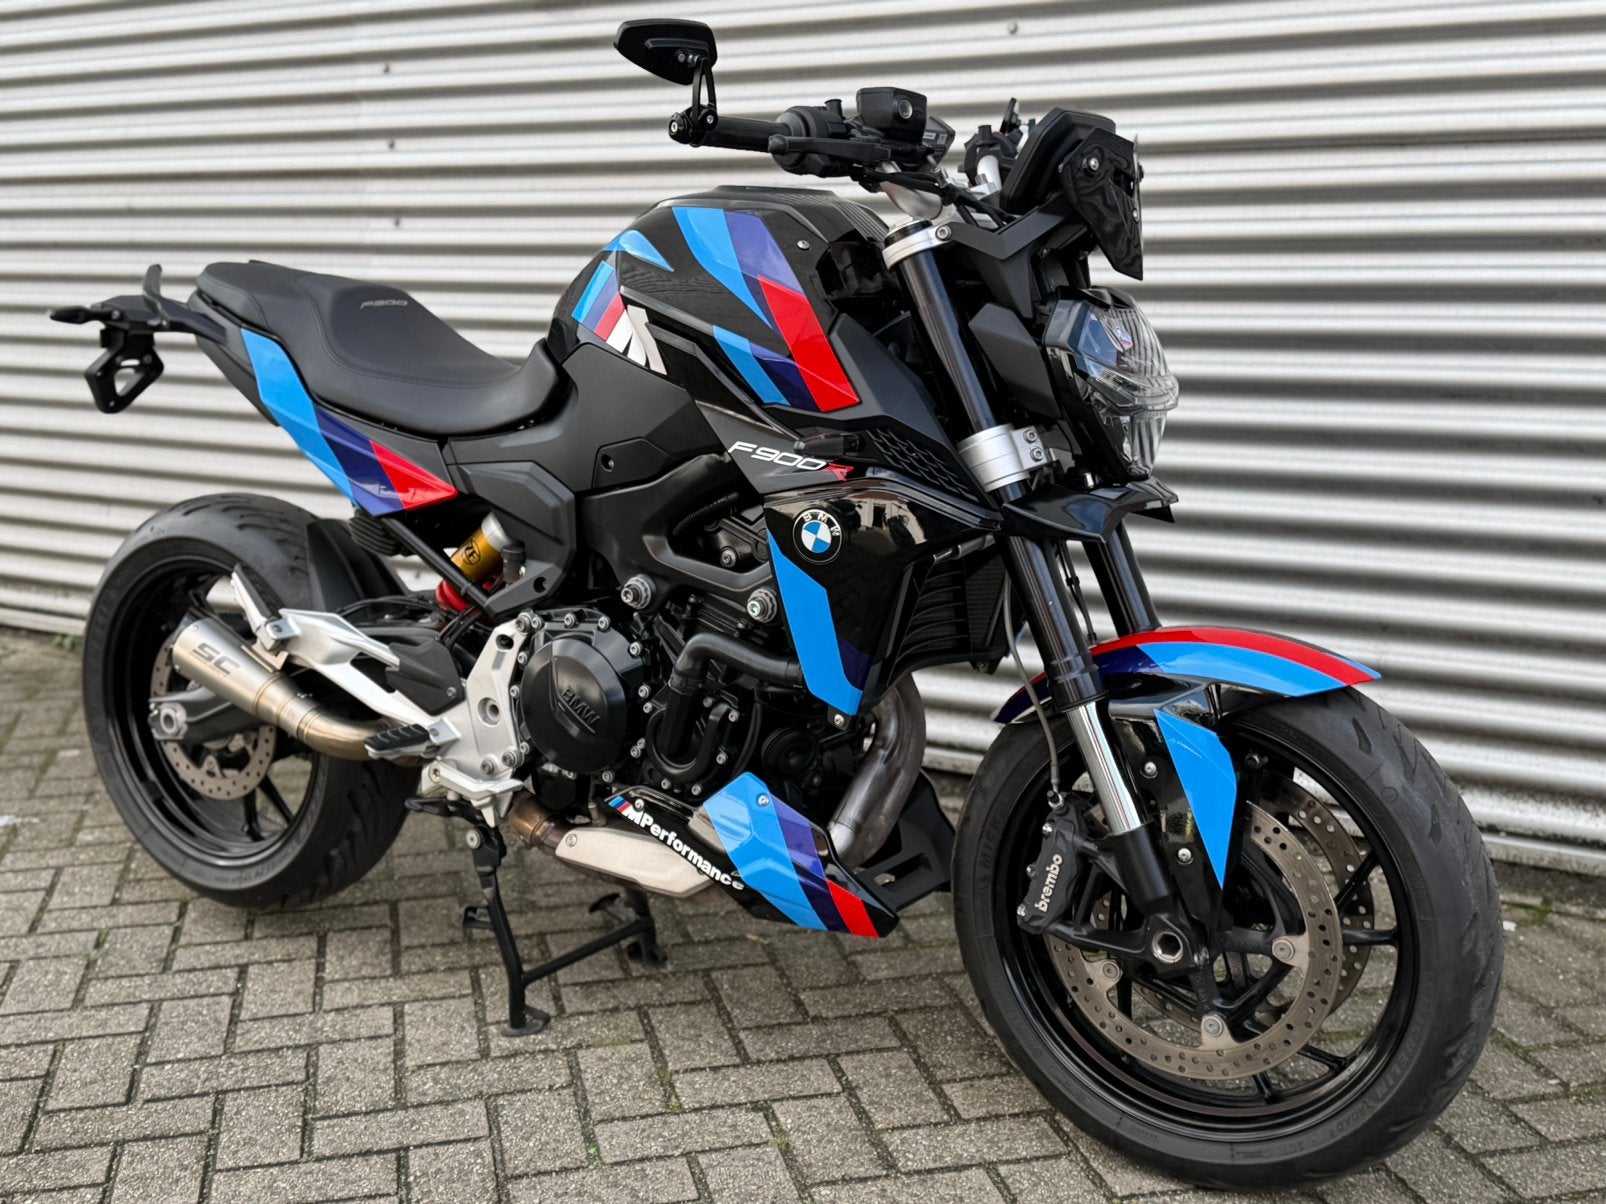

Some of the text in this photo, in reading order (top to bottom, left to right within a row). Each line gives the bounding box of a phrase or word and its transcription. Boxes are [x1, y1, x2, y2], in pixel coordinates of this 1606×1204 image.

[802, 511, 840, 536] BMW
[561, 688, 601, 723] BMW
[1034, 854, 1063, 912] brembo
